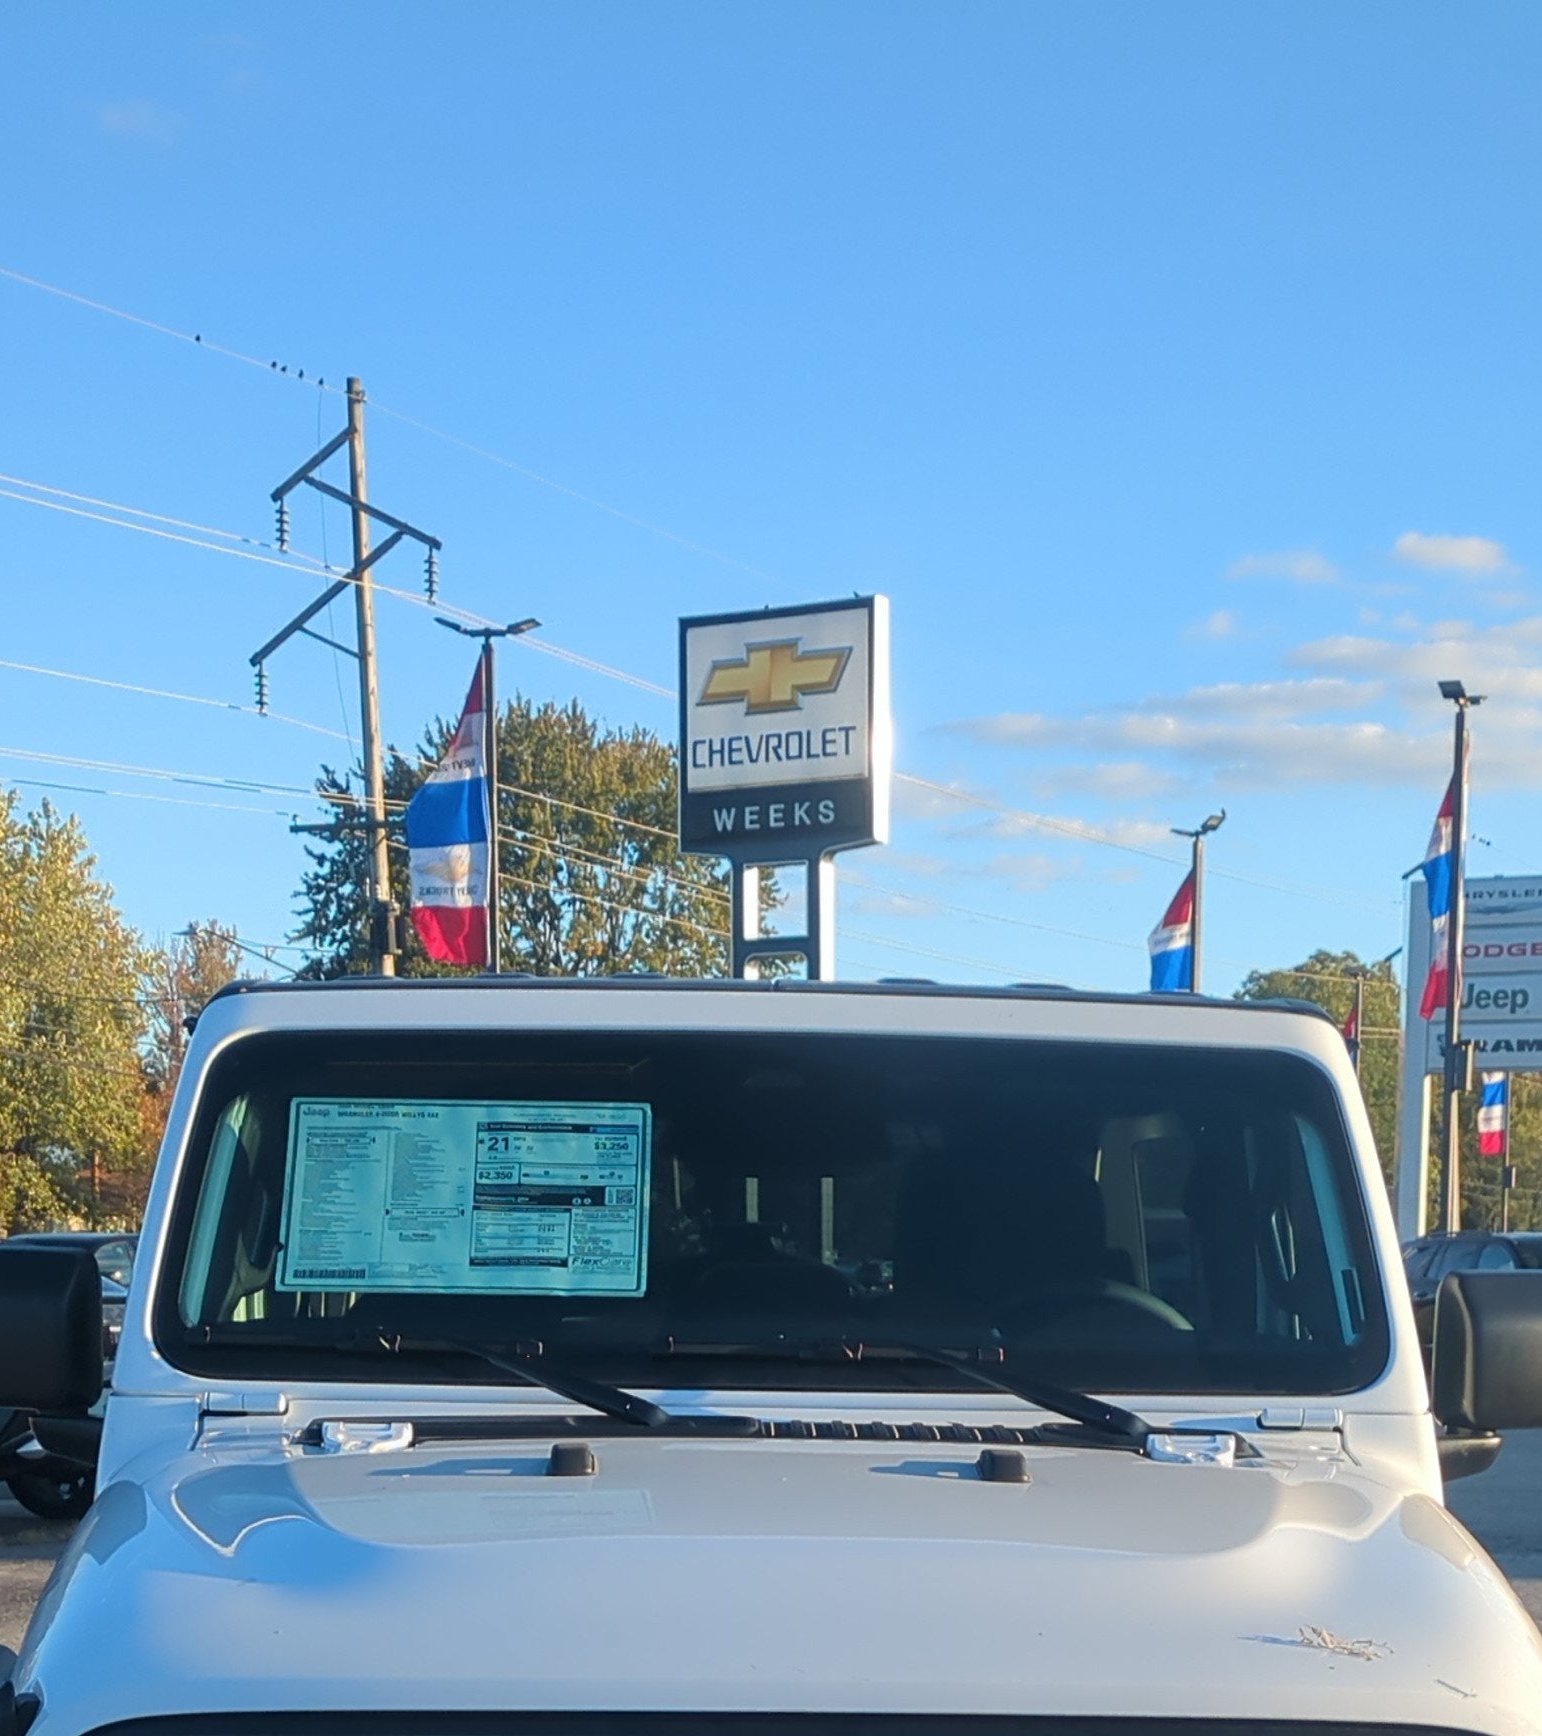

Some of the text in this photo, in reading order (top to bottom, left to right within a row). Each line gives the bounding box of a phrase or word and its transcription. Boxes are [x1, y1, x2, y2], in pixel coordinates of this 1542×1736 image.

[692, 726, 856, 769] CHEVROLET
[713, 800, 836, 832] WEEKS
[1460, 983, 1530, 1015] Jeep
[488, 1136, 509, 1151] 21
